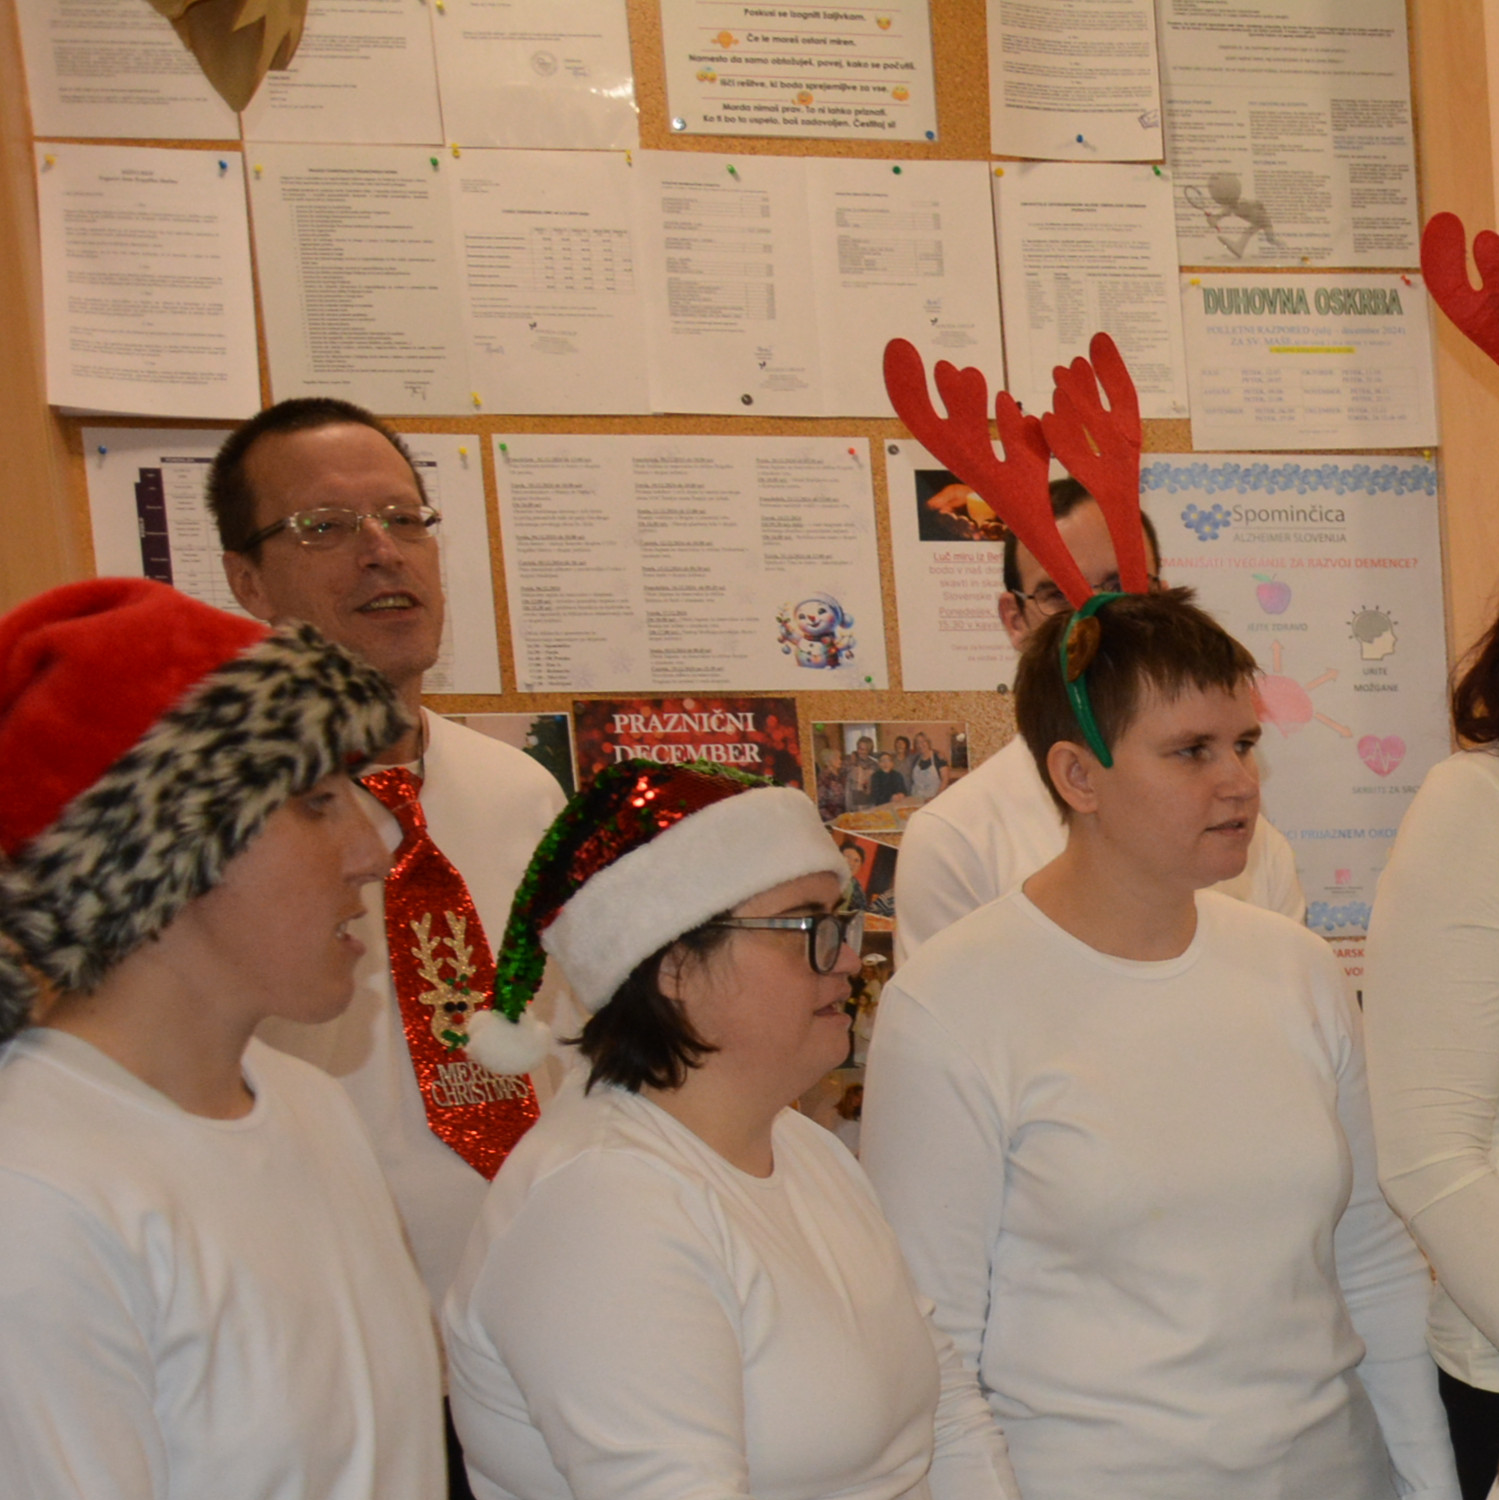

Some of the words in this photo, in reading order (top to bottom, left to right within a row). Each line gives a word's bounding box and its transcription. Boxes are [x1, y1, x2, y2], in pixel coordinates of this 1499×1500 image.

[1203, 287, 1311, 316] DUHOVNA
[1314, 287, 1404, 316] OSKRBA
[1232, 503, 1346, 527] Spominčica
[1233, 532, 1291, 543] ALZHEIMER
[1293, 532, 1347, 543] SLOVENIJA
[1289, 557, 1305, 568] ZA
[1308, 557, 1352, 568] RAZVOJ
[1354, 557, 1419, 569] DEMENCE?
[612, 708, 758, 734] PRAZNIČNI
[613, 743, 764, 766] DECEMBER
